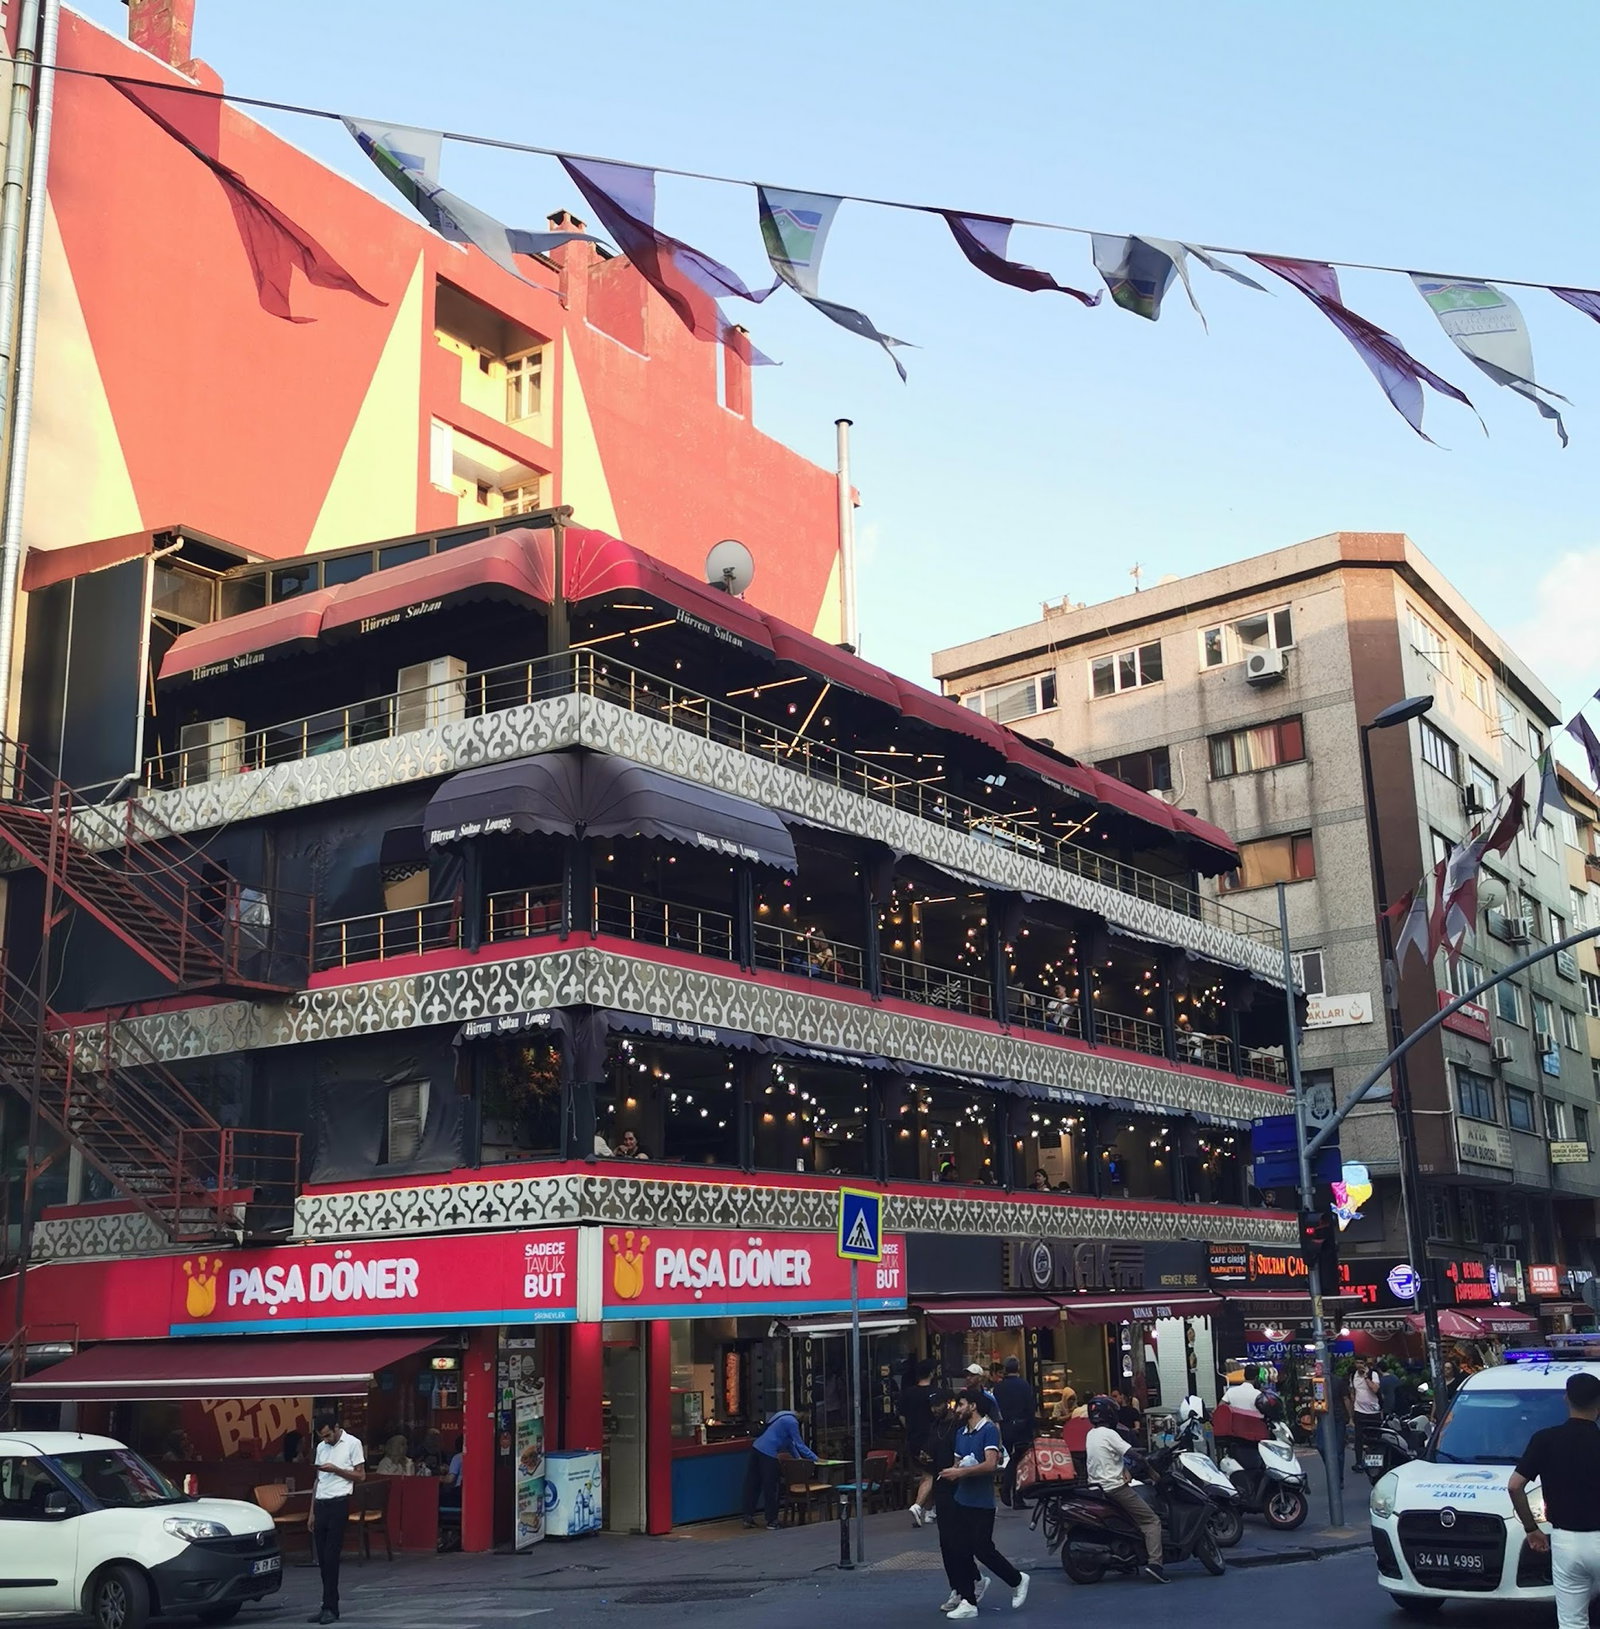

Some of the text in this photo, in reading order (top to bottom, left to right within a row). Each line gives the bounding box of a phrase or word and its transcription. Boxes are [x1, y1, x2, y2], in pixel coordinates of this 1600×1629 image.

[360, 601, 442, 633] Hürrem Sultan
[676, 608, 743, 647] Hürrem Sultan
[192, 653, 265, 681] Hürrem Sultan
[524, 1241, 566, 1257] SADECE
[524, 1255, 566, 1273] TAVUK
[655, 1237, 811, 1299] PAŞA DÖNER
[1210, 1256, 1226, 1265] CAFE
[1256, 1254, 1286, 1275] SULTAN
[228, 1249, 419, 1315] PAŞA DÖNER
[524, 1272, 566, 1298] BUT
[876, 1268, 900, 1289] BUT
[970, 1313, 1024, 1328] KONAK FIRIN
[1253, 1344, 1265, 1353] VE
[1038, 1450, 1072, 1472] go
[1432, 1491, 1476, 1499] ZABITA
[1419, 1552, 1482, 1568] 34 VA 4995
